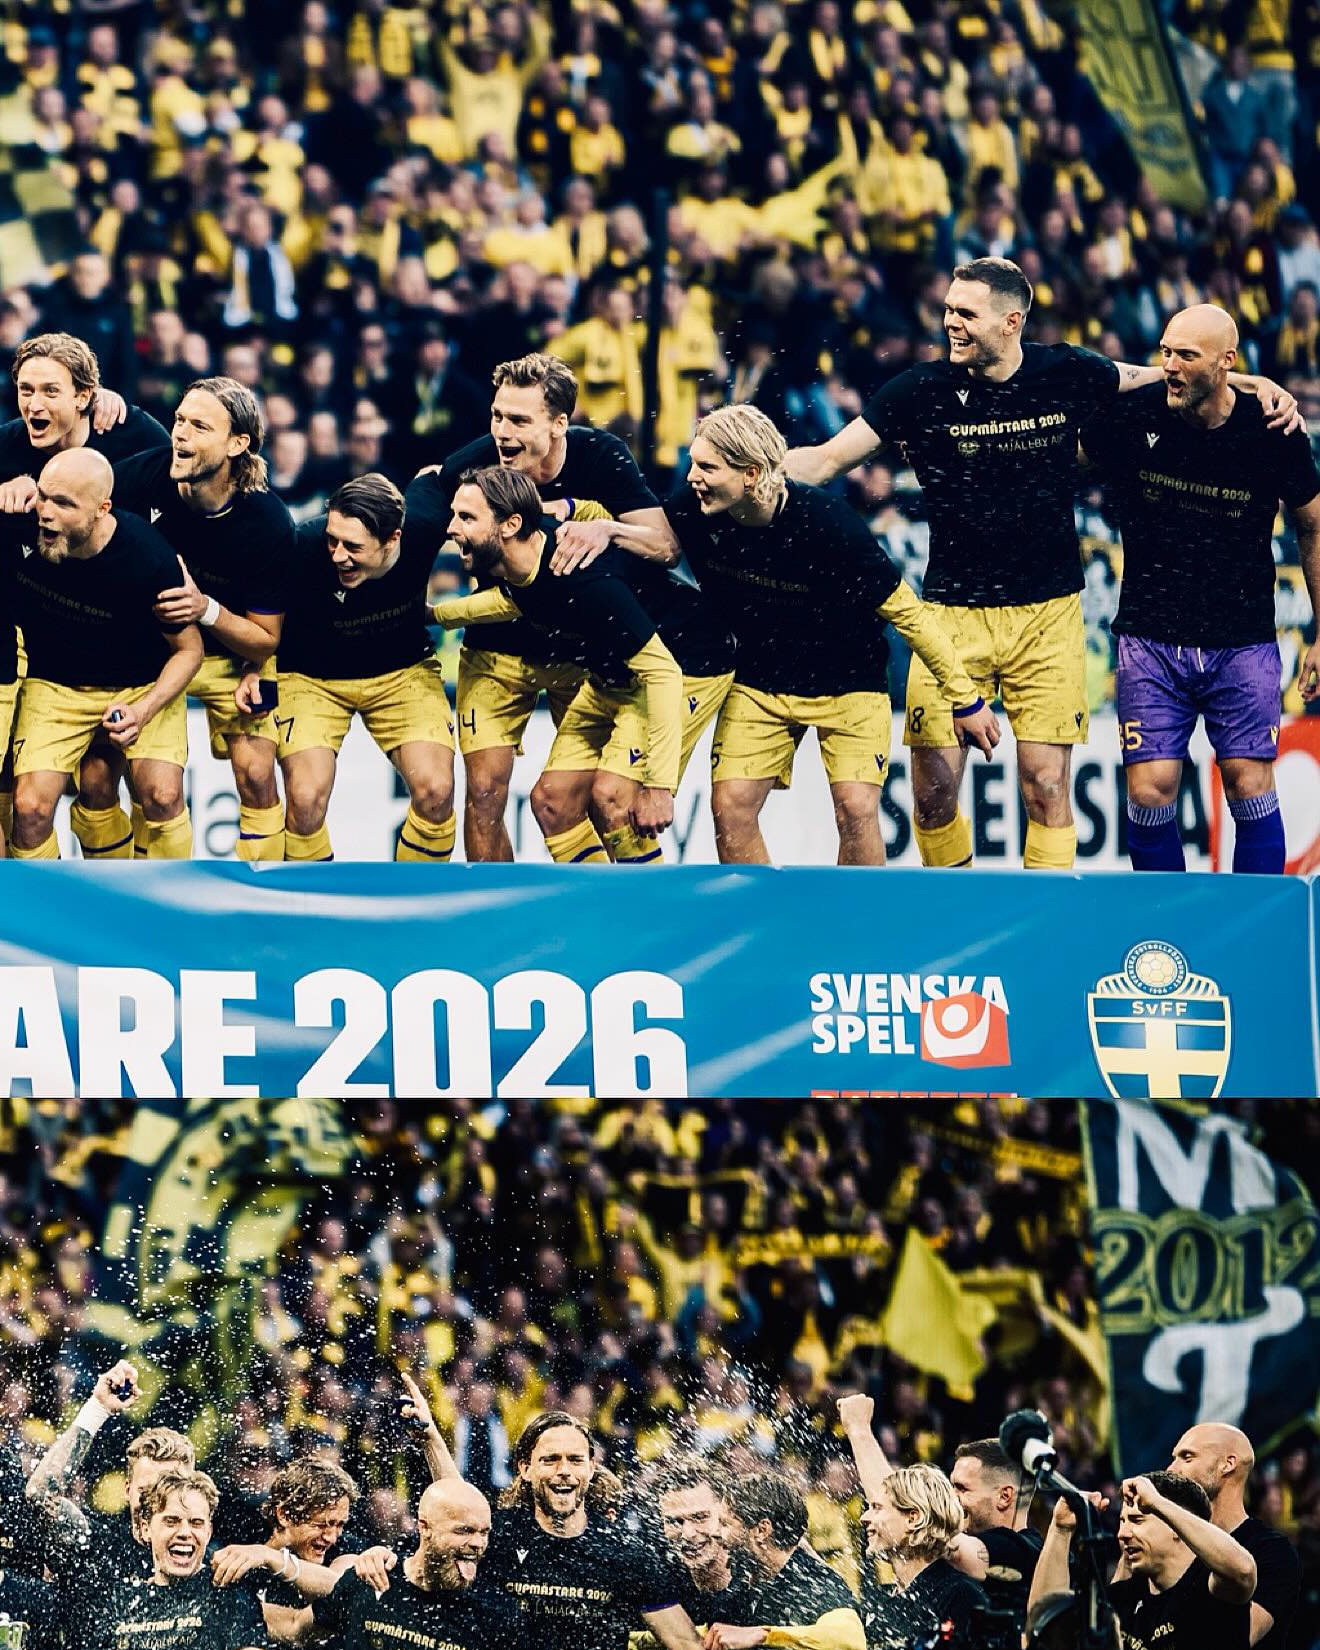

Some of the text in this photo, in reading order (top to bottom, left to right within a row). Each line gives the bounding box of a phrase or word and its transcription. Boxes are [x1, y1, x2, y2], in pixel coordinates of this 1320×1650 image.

[946, 411, 1067, 437] CUPMÄSTARE 2026
[1218, 487, 1250, 503] 2026
[809, 973, 1010, 1015] SVENSKA
[1131, 1000, 1189, 1017] SvFF
[294, 968, 688, 1098] 2026
[811, 1014, 916, 1054] SPEL
[1142, 1287, 1304, 1425] T
[363, 1620, 436, 1650] CUPMÄSTARE
